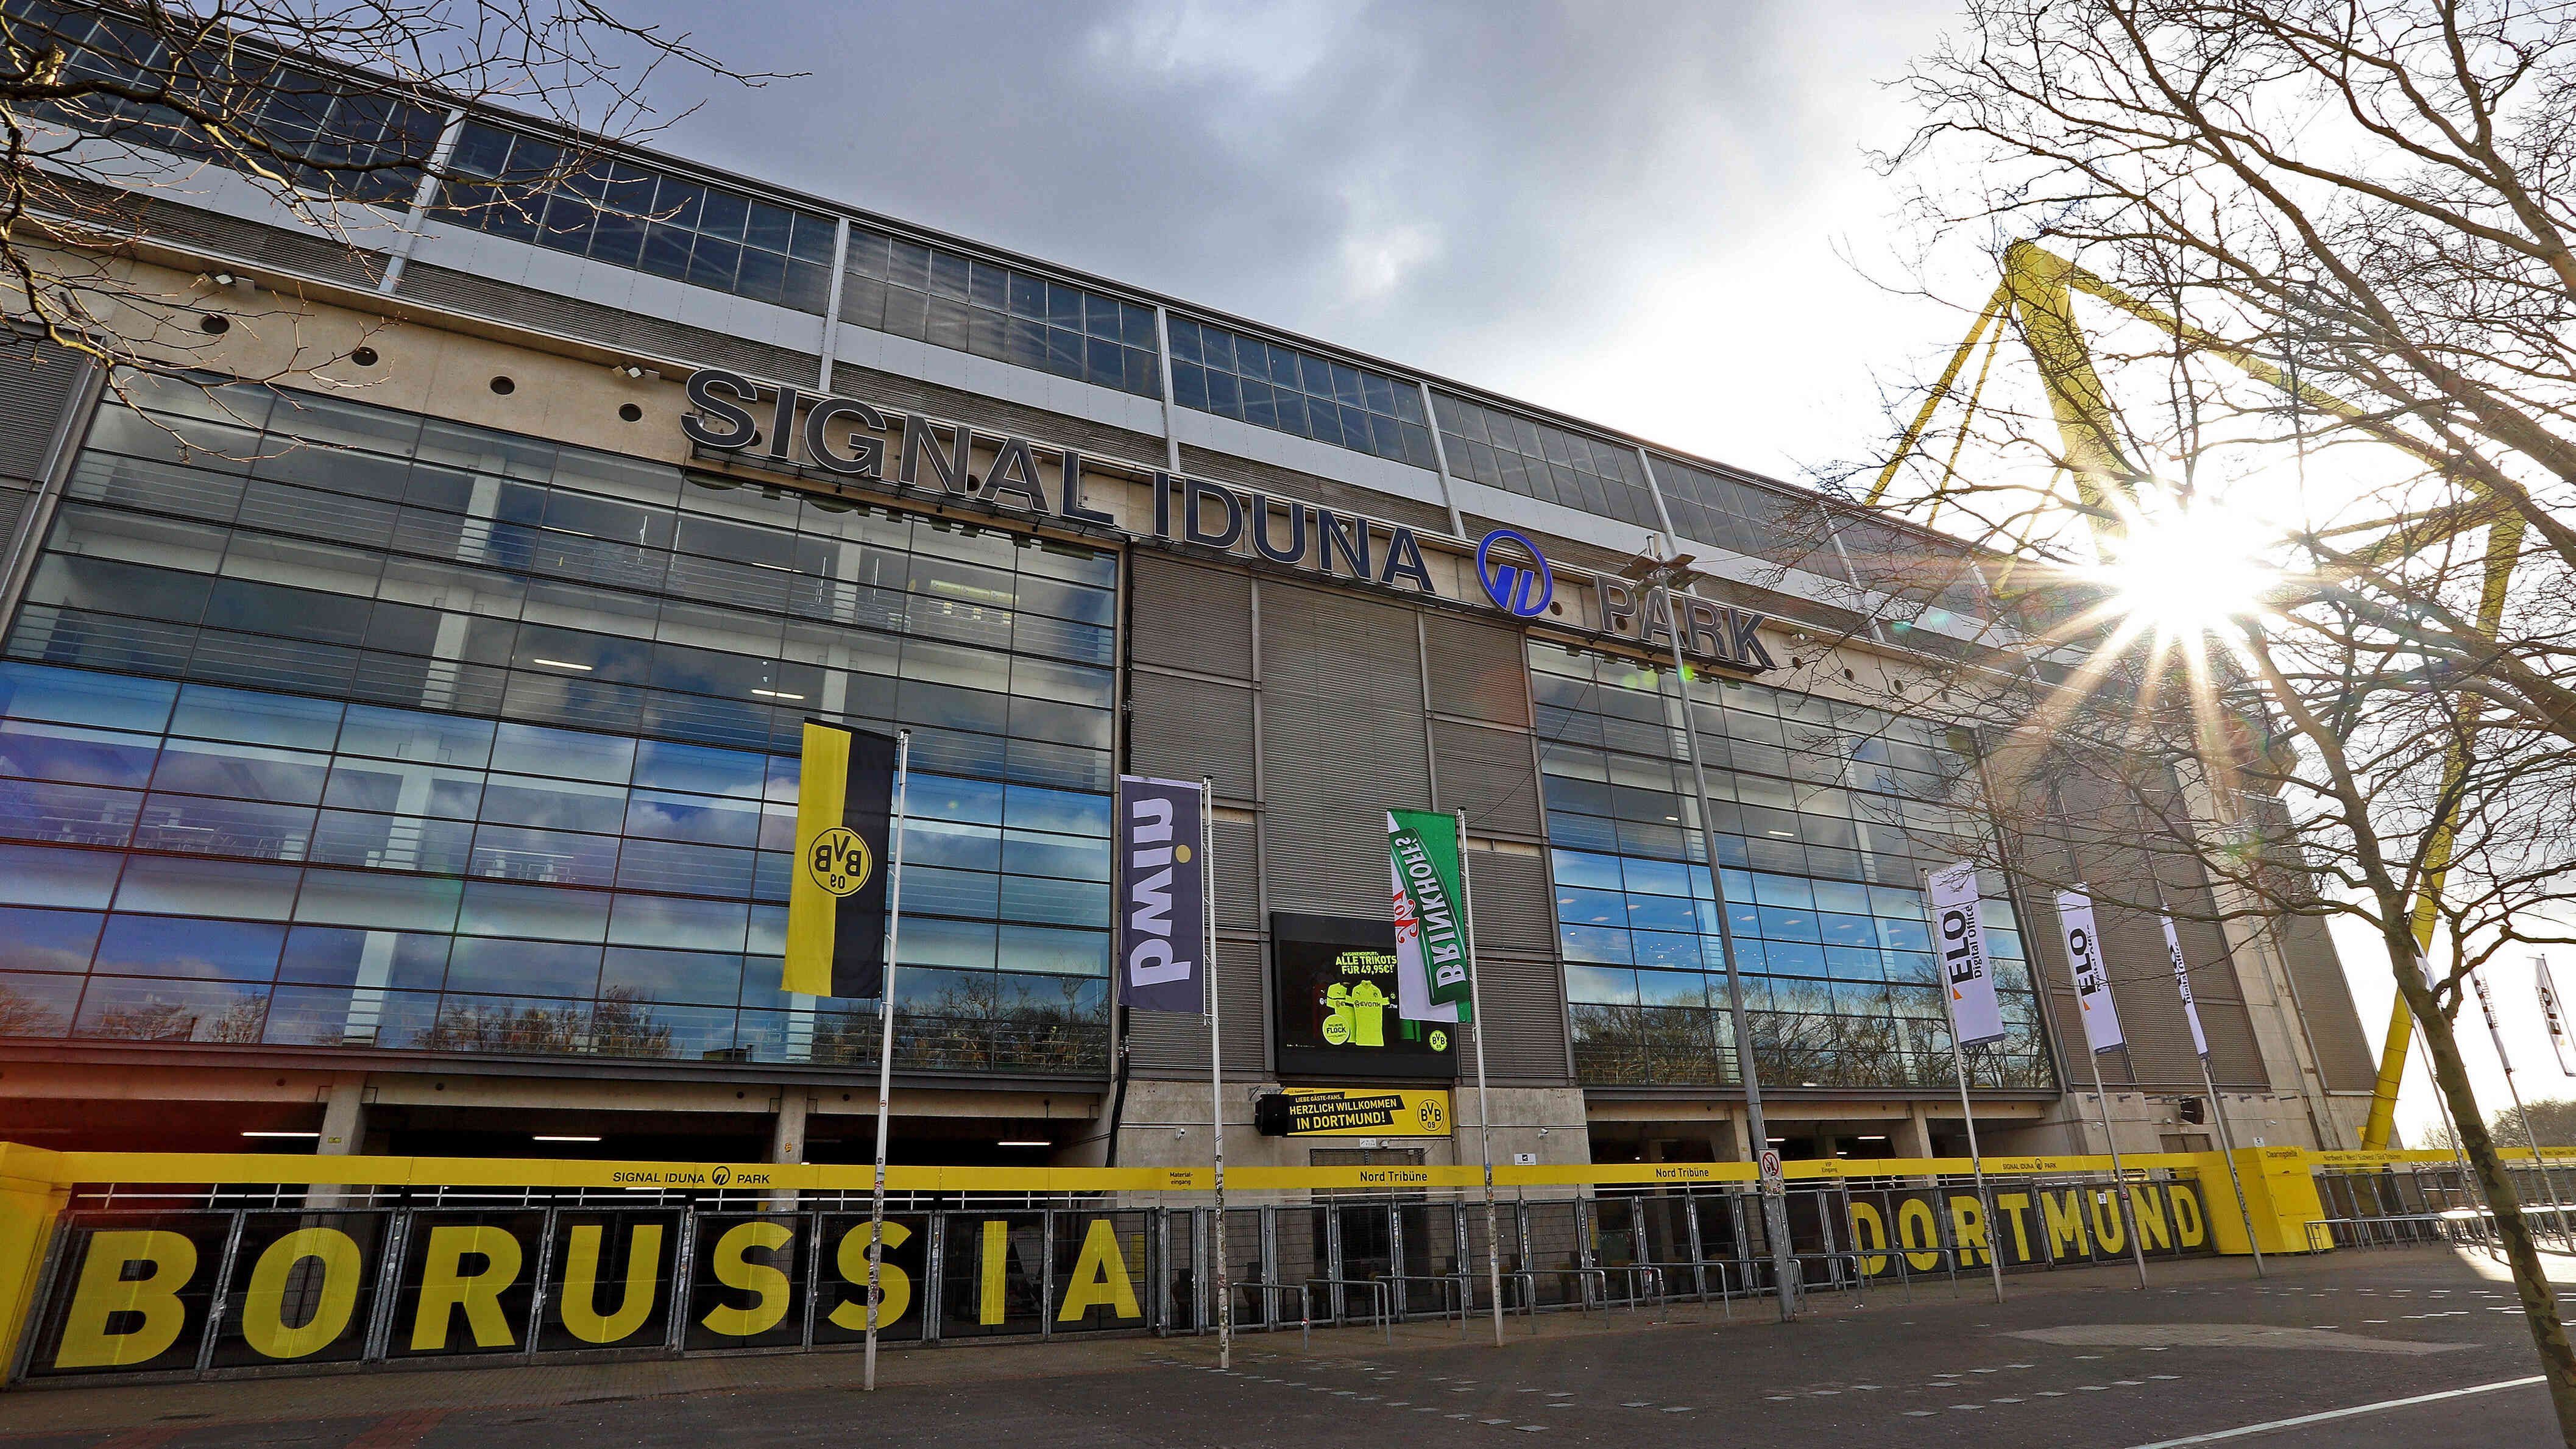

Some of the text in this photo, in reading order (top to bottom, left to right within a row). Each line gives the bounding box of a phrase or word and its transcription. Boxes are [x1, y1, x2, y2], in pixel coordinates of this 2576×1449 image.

[680, 369, 1777, 670] SIGNAL IDUNA PARK
[1942, 910, 1974, 985] ELO
[1966, 904, 1983, 979] Digital Office
[1336, 955, 1397, 966] ALLE TRIKOTS
[1342, 965, 1360, 974] FÜR
[2070, 928, 2097, 997] ELO
[1432, 1033, 1445, 1044] BVB
[1289, 1098, 1397, 1116] HERZLICH WILLKOMMEN
[1420, 1102, 1442, 1122] BVB
[1297, 1111, 1385, 1130] IN DORTMUND!
[613, 1172, 770, 1183] SIGNAL IDUNA PARK
[1359, 1171, 1428, 1182] Nord Tribüne
[1655, 1167, 1709, 1178] Nord Tribüne
[1850, 1185, 2205, 1276] DORTMUND
[54, 1219, 1142, 1369] BORUSSIA
